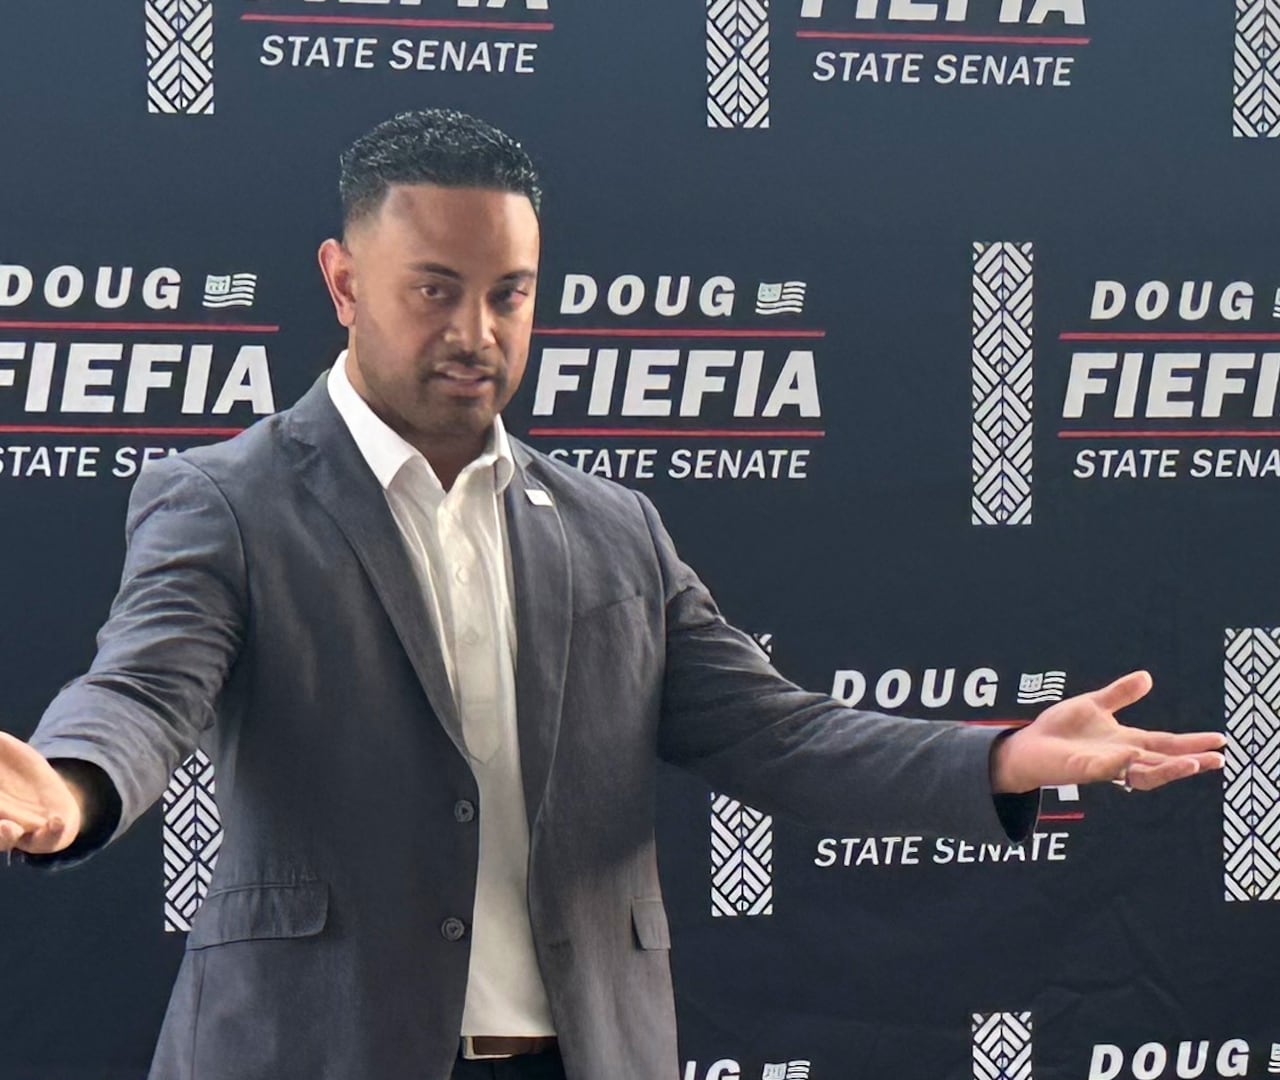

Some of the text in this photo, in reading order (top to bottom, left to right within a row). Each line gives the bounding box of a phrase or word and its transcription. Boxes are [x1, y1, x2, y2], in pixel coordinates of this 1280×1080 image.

[260, 35, 538, 73] STATE SENATE
[812, 51, 1075, 86] STATE SENATE
[559, 274, 736, 317] DOUG
[1090, 280, 1254, 321] DOUG
[532, 348, 821, 418] FIEFIA
[668, 449, 810, 479] SENATE
[1073, 449, 1180, 478] STATE
[832, 668, 999, 708] DOUG
[814, 836, 923, 867] STATE
